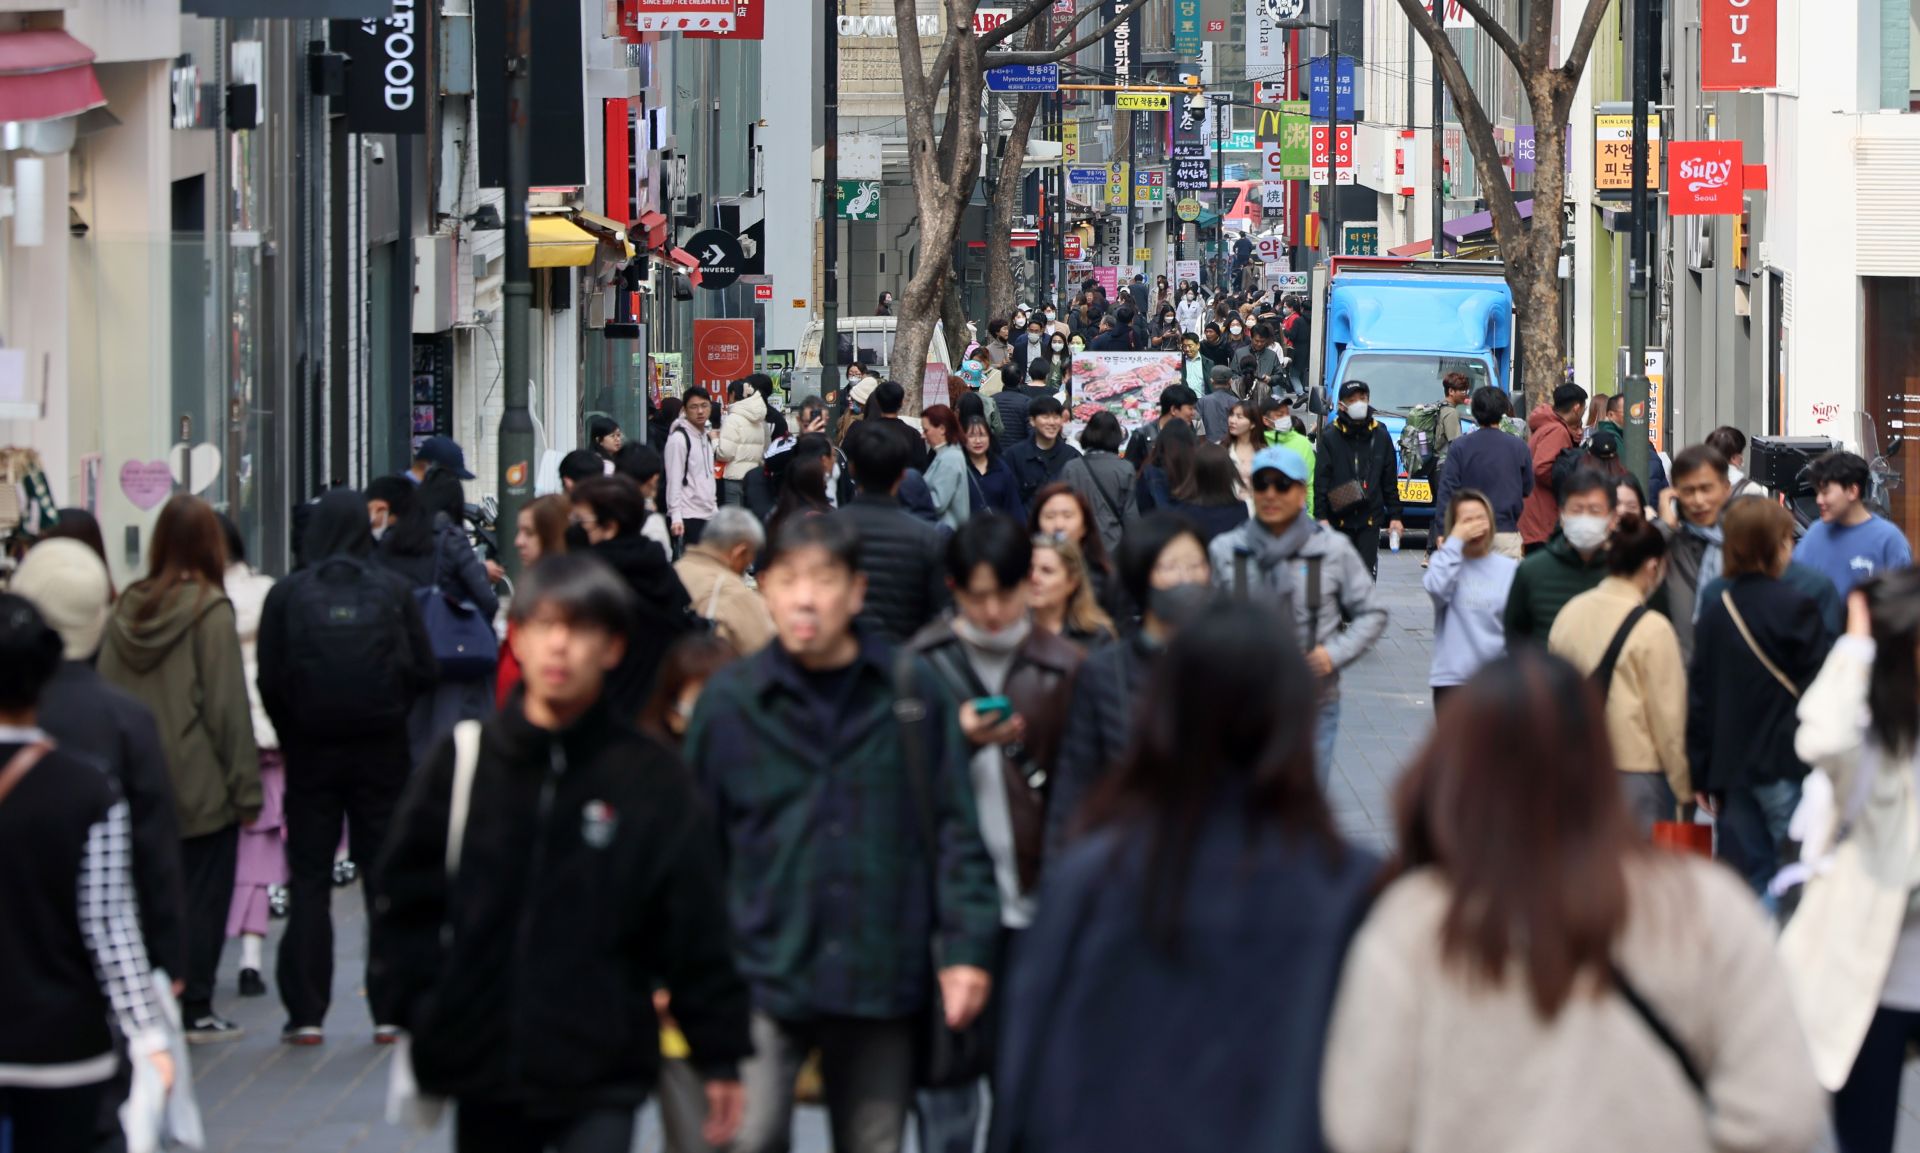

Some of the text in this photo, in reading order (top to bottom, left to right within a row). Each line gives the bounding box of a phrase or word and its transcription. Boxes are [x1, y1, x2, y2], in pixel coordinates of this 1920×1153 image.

[1210, 22, 1222, 31] 5G
[1027, 65, 1056, 75] 명동8길
[1118, 97, 1159, 107] CCTV 작동중
[1679, 157, 1732, 187] Supy
[1694, 194, 1717, 202] Seoul
[1259, 239, 1279, 260] 약
[1812, 403, 1840, 418] Supy
